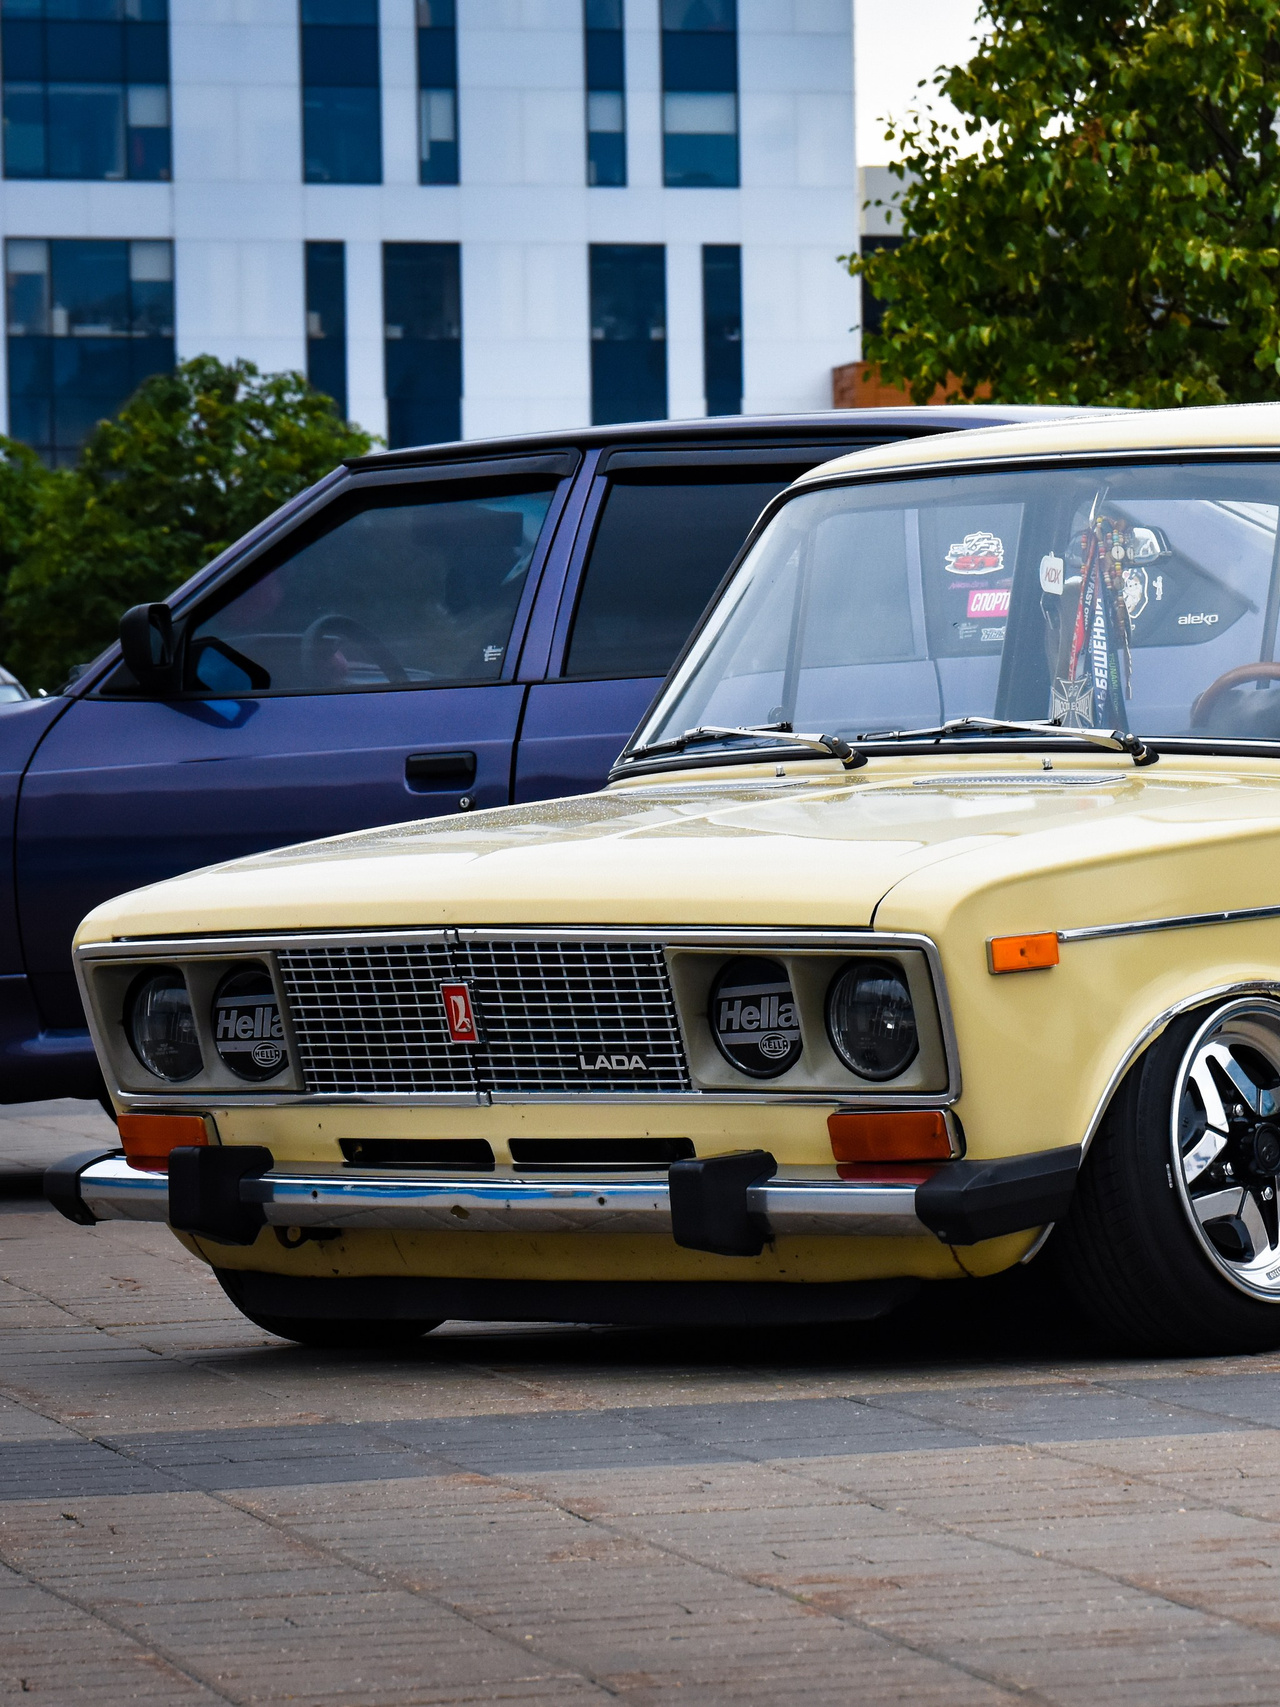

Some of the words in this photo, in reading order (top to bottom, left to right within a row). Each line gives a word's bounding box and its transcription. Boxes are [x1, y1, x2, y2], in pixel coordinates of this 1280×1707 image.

[1177, 612, 1219, 626] aleko
[720, 995, 799, 1031] Hella
[216, 1006, 285, 1040] Hella
[762, 1040, 789, 1051] HELLA
[255, 1049, 280, 1060] HELLA
[579, 1054, 648, 1070] LADA
